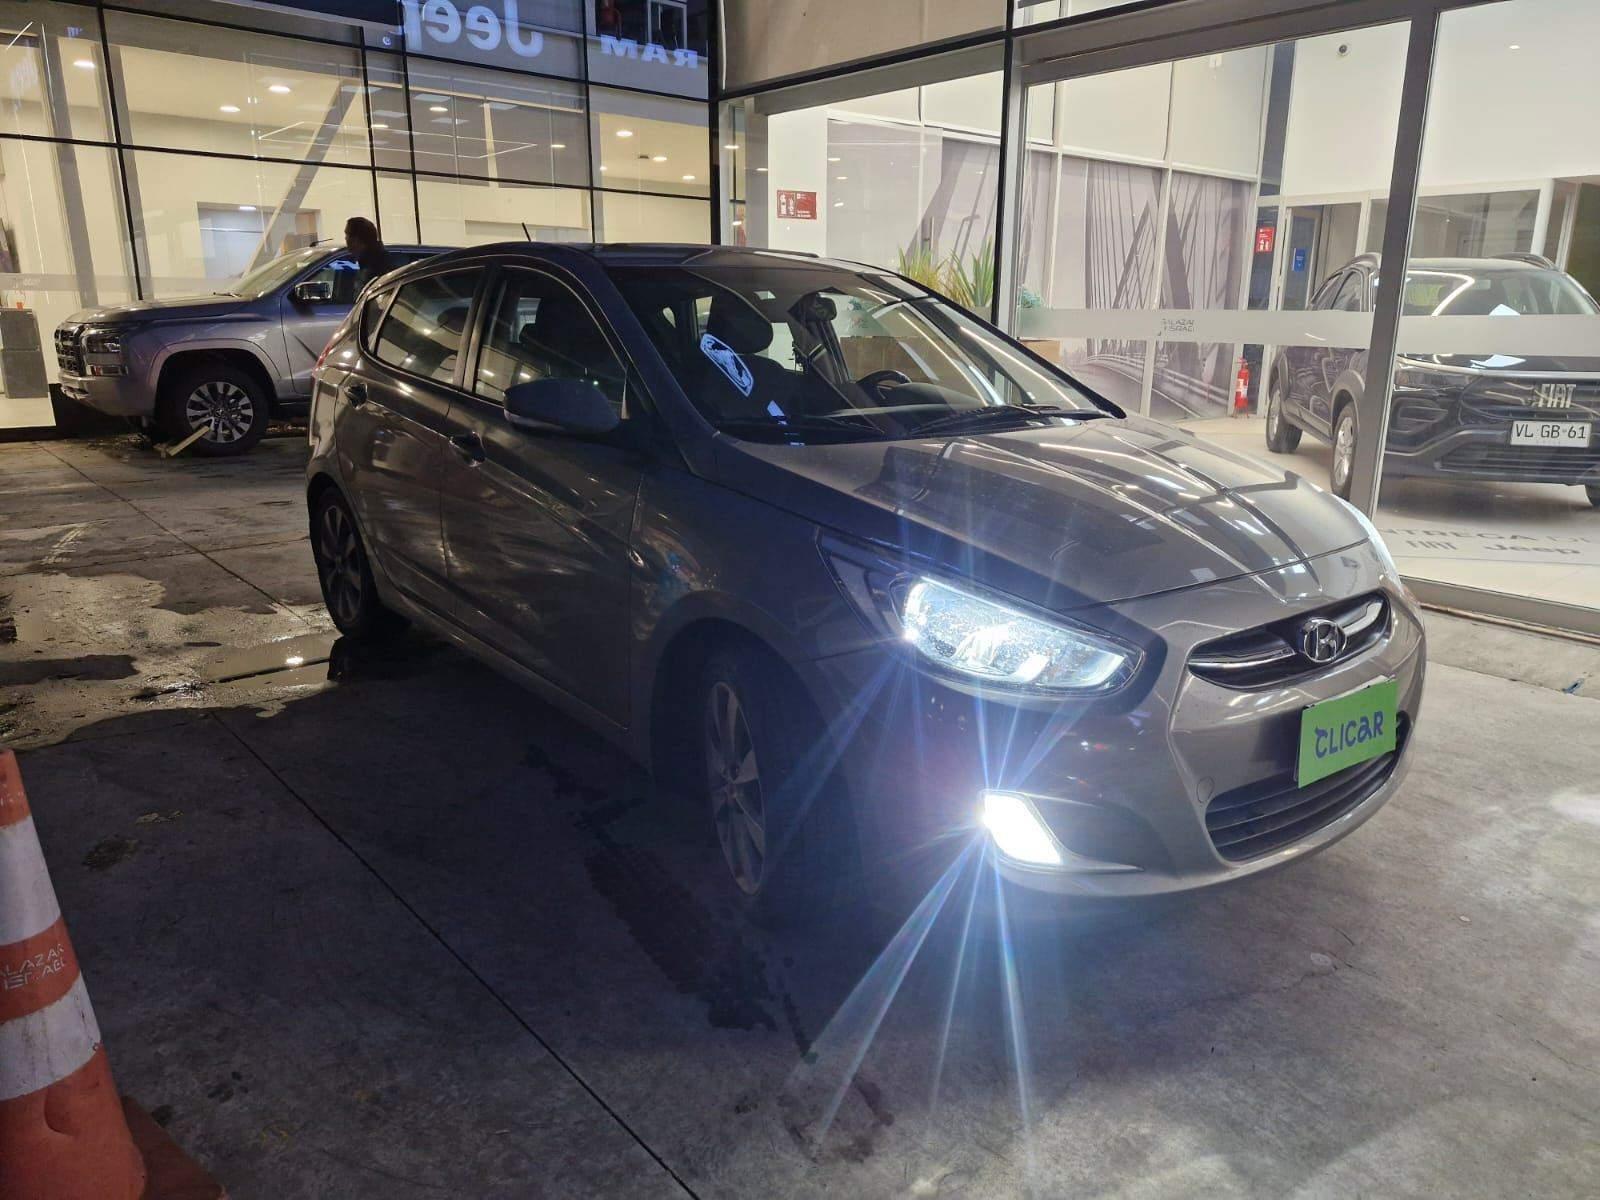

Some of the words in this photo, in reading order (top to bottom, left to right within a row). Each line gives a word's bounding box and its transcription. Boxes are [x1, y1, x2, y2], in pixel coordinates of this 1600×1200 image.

[1538, 384, 1576, 408] FIAT
[1516, 424, 1533, 438] VL
[1541, 425, 1560, 438] GB
[1568, 426, 1586, 439] 61
